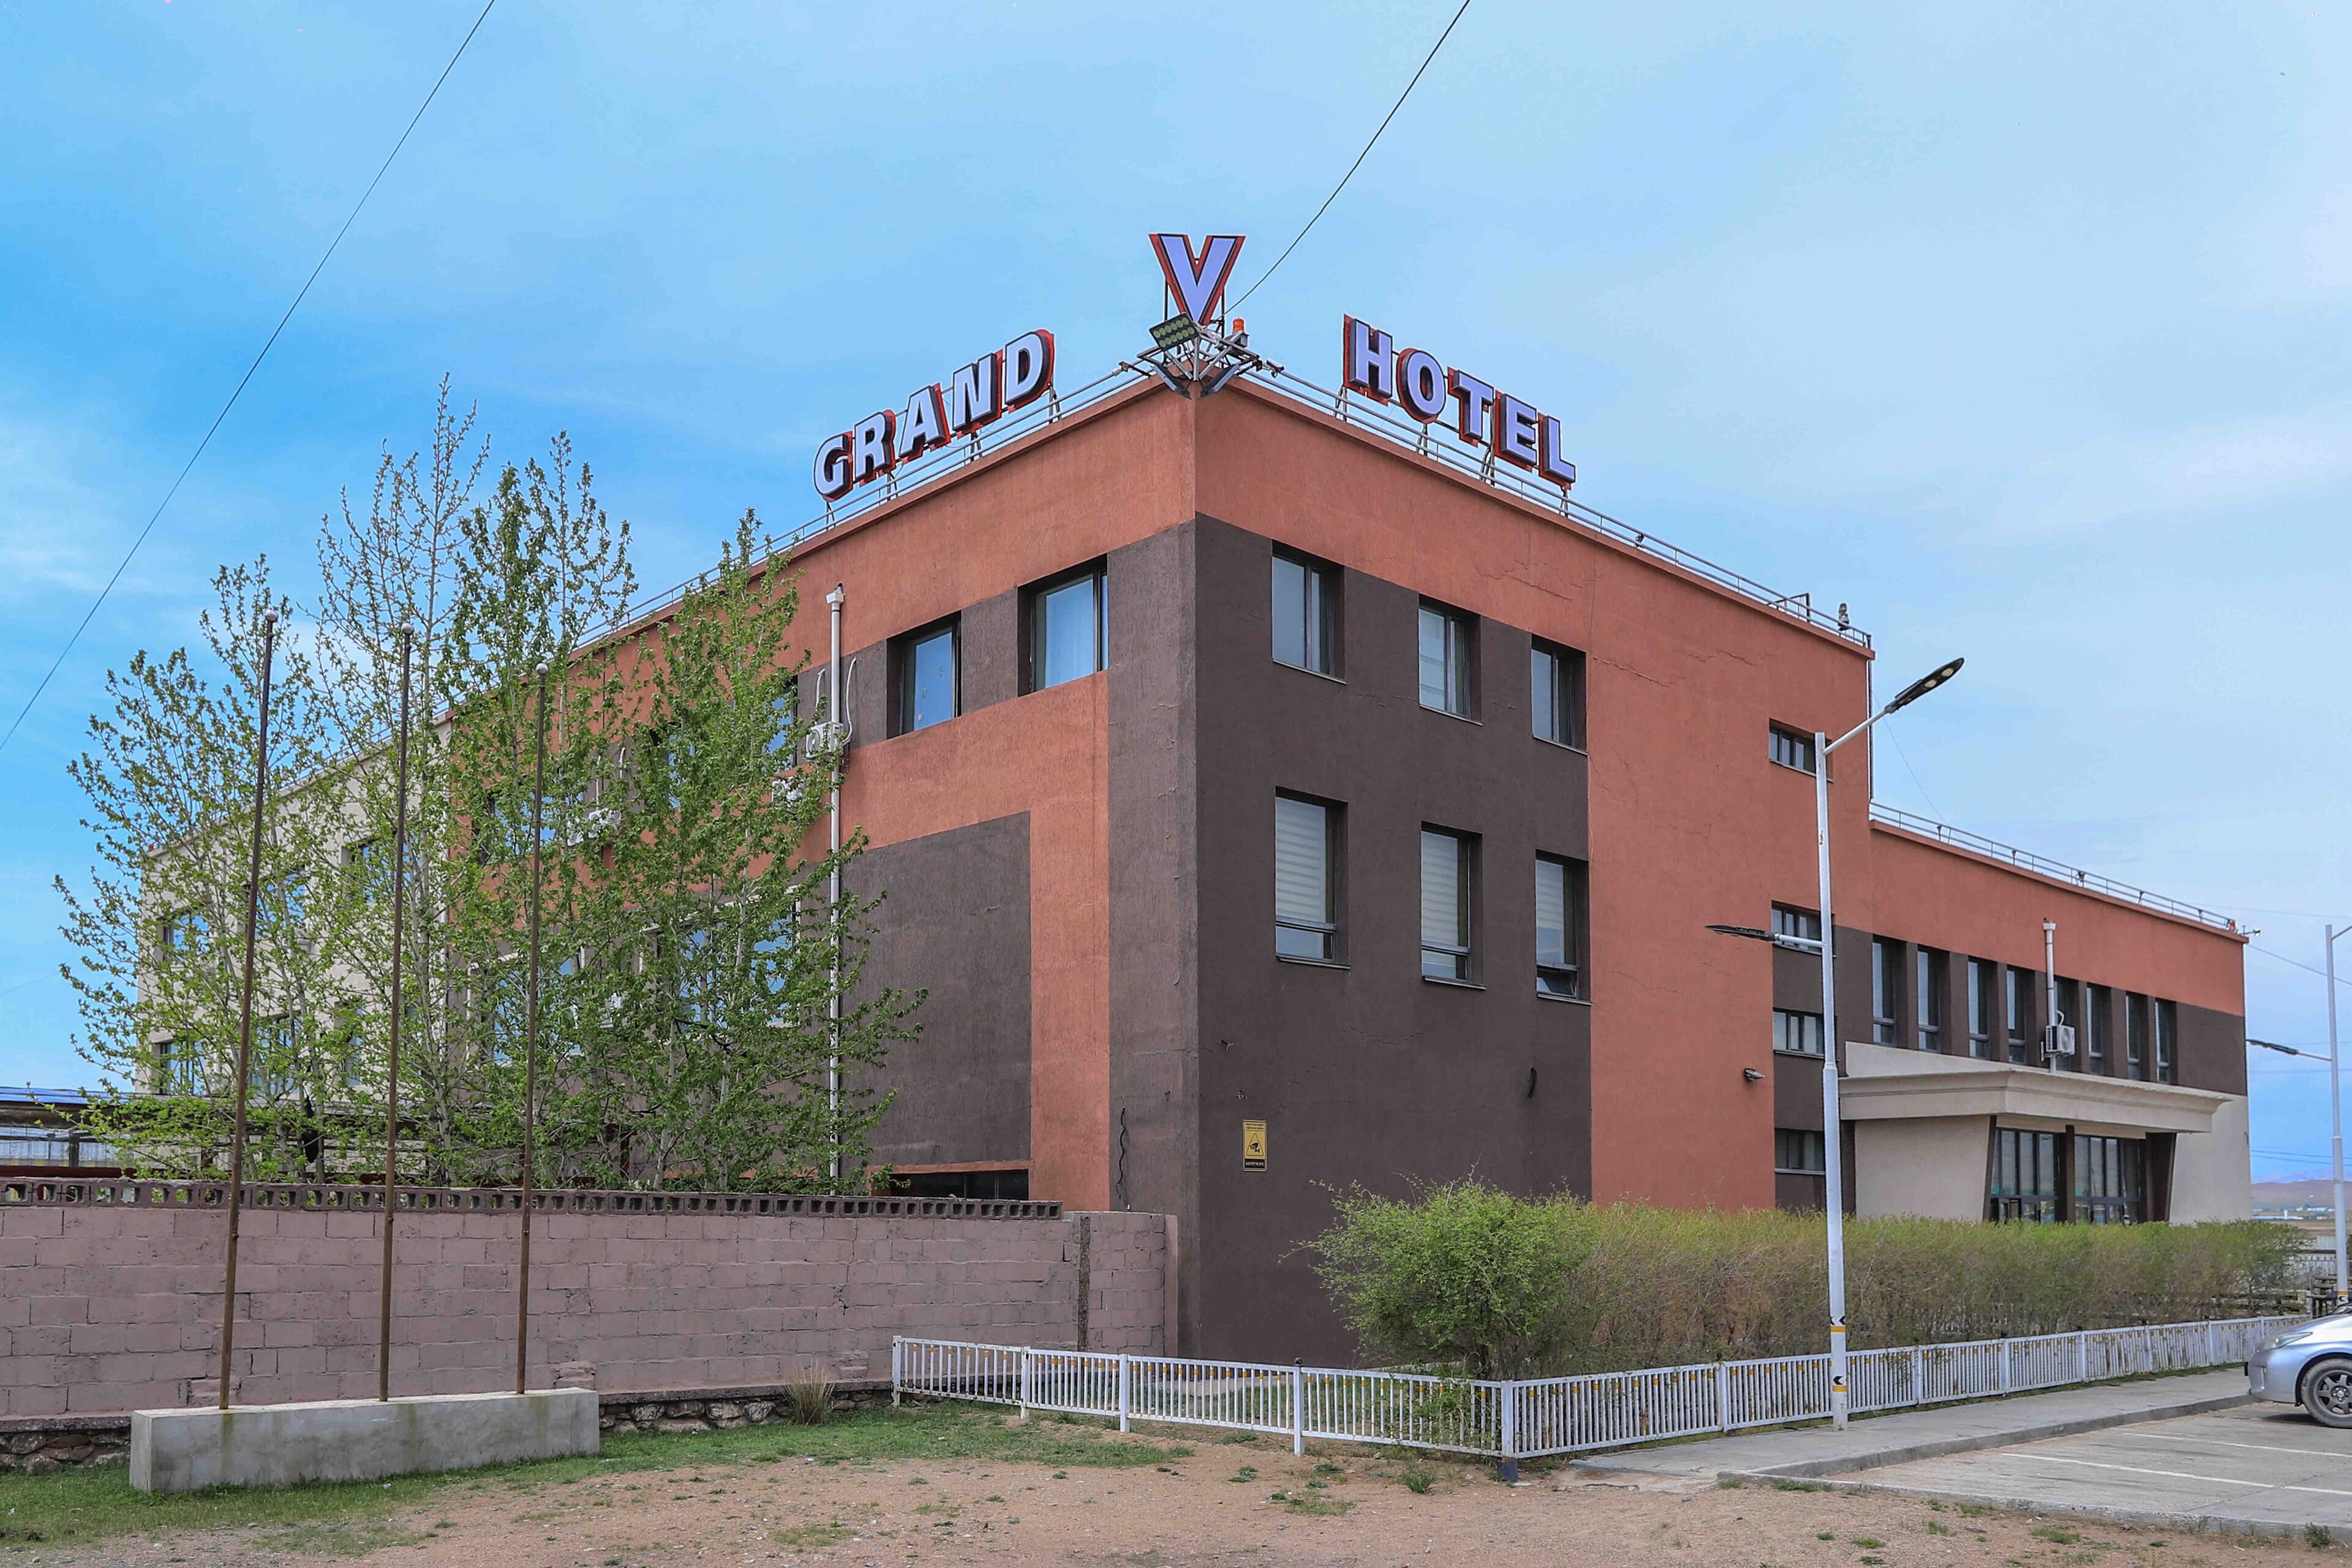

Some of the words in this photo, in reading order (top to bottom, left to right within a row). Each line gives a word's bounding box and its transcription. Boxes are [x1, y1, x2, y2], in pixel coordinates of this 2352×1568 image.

[813, 329, 1054, 502] GRAND
[1148, 233, 1246, 326] V
[1344, 314, 1576, 489] HOTEL
